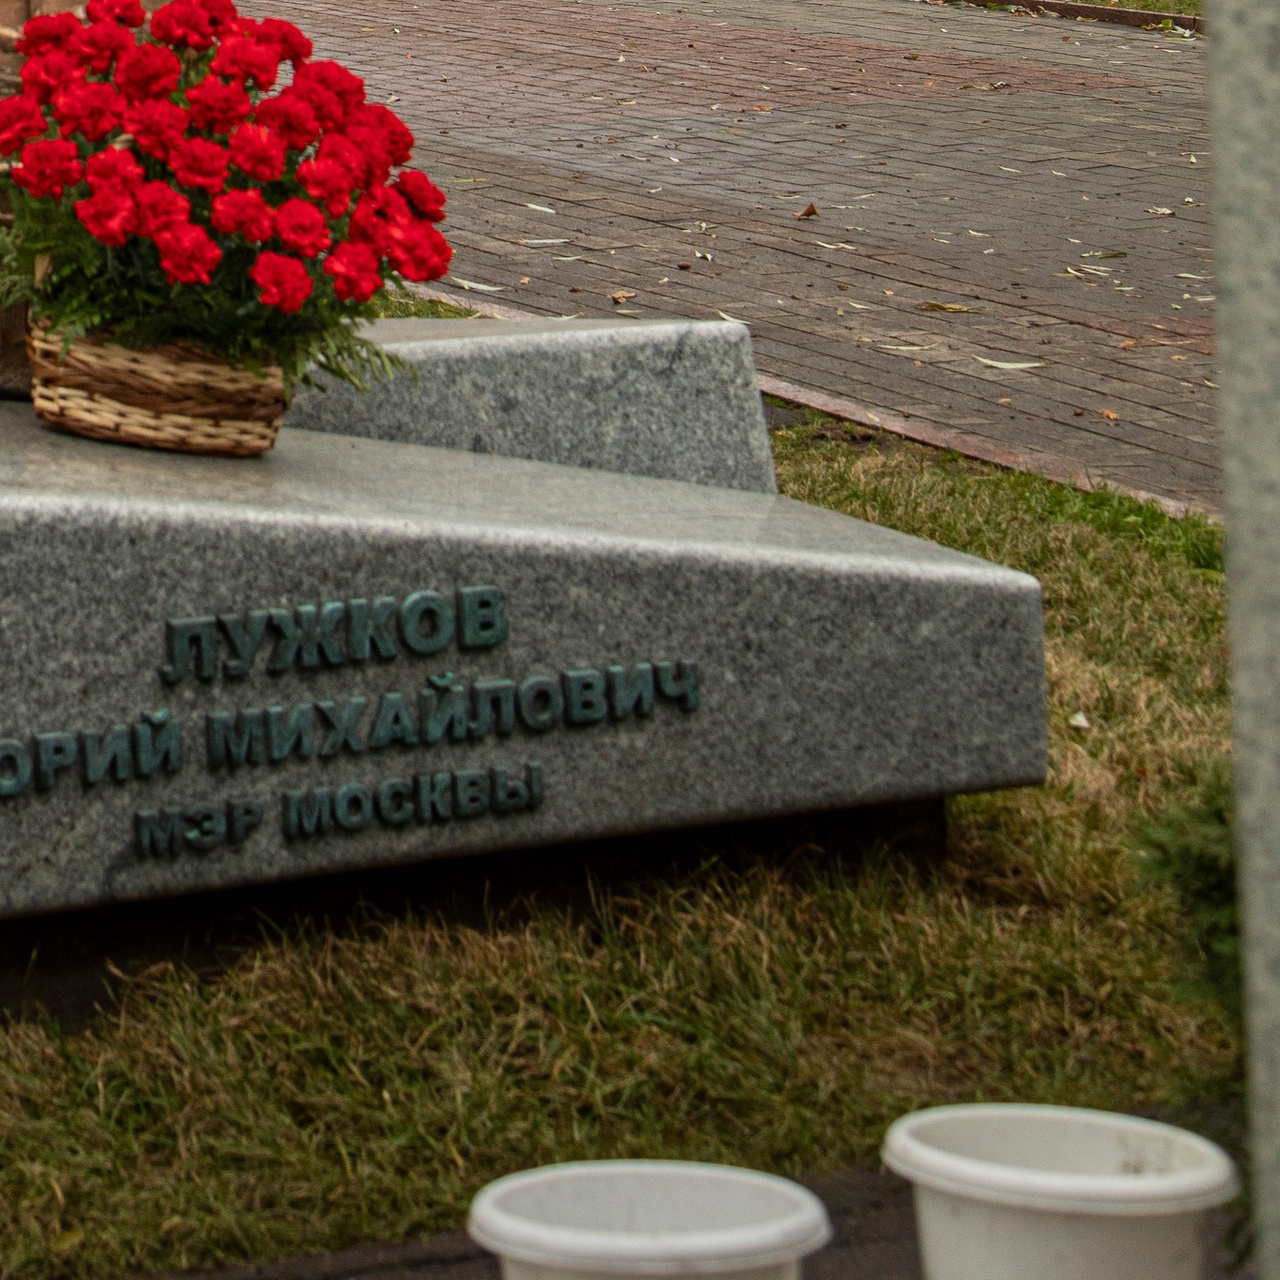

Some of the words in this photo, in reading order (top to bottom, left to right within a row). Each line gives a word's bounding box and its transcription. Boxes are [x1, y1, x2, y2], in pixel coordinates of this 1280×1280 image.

[158, 584, 510, 686] ЛУЖКОВ
[206, 660, 701, 771] МИХАЙЛОВИЧ
[133, 800, 265, 858] МЭР
[281, 759, 545, 840] МОСКВЫ
